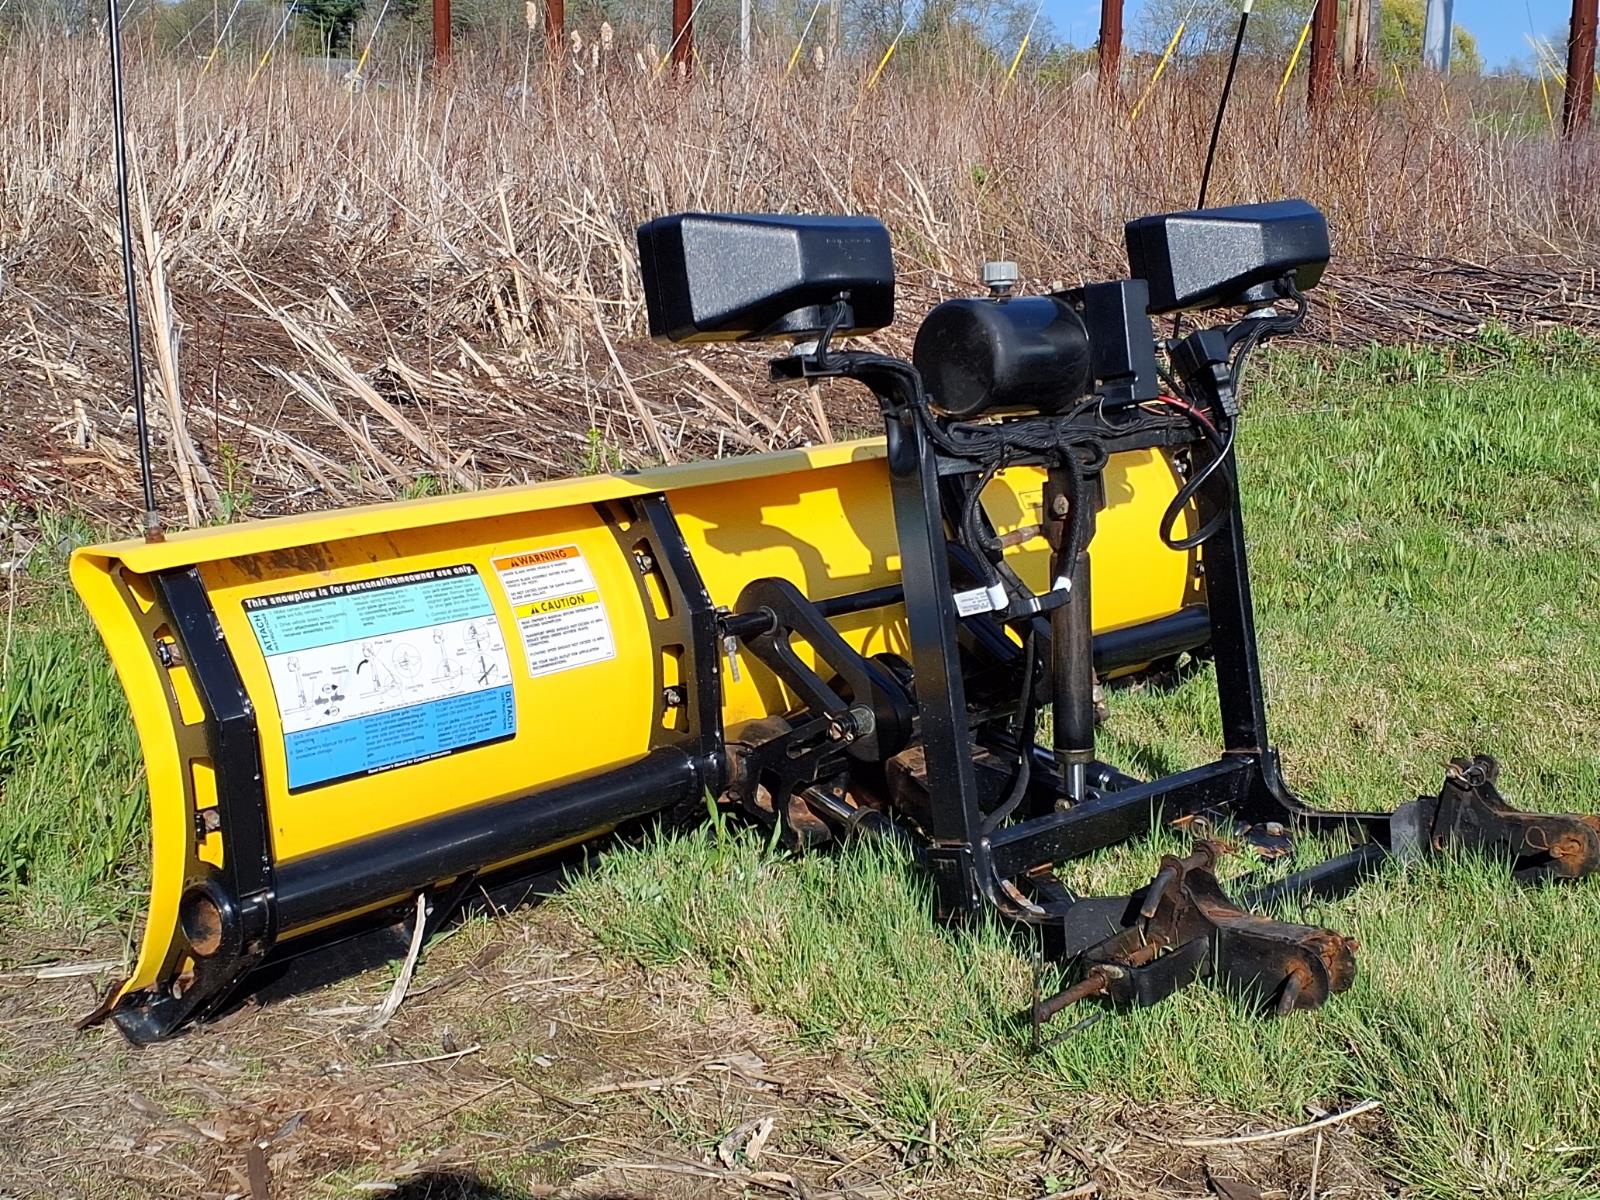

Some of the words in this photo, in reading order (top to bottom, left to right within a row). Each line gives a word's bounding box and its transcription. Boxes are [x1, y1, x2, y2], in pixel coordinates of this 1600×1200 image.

[518, 549, 567, 566] WARNING
[245, 599, 269, 609] This
[270, 591, 317, 605] snowplow
[319, 587, 328, 597] is
[330, 585, 344, 595] for
[346, 571, 435, 593] personal/homeowner
[437, 567, 452, 577] use
[453, 565, 475, 575] only.
[541, 595, 585, 612] CAUTION
[253, 615, 274, 652] ATTACH
[505, 691, 514, 729] DETACH
